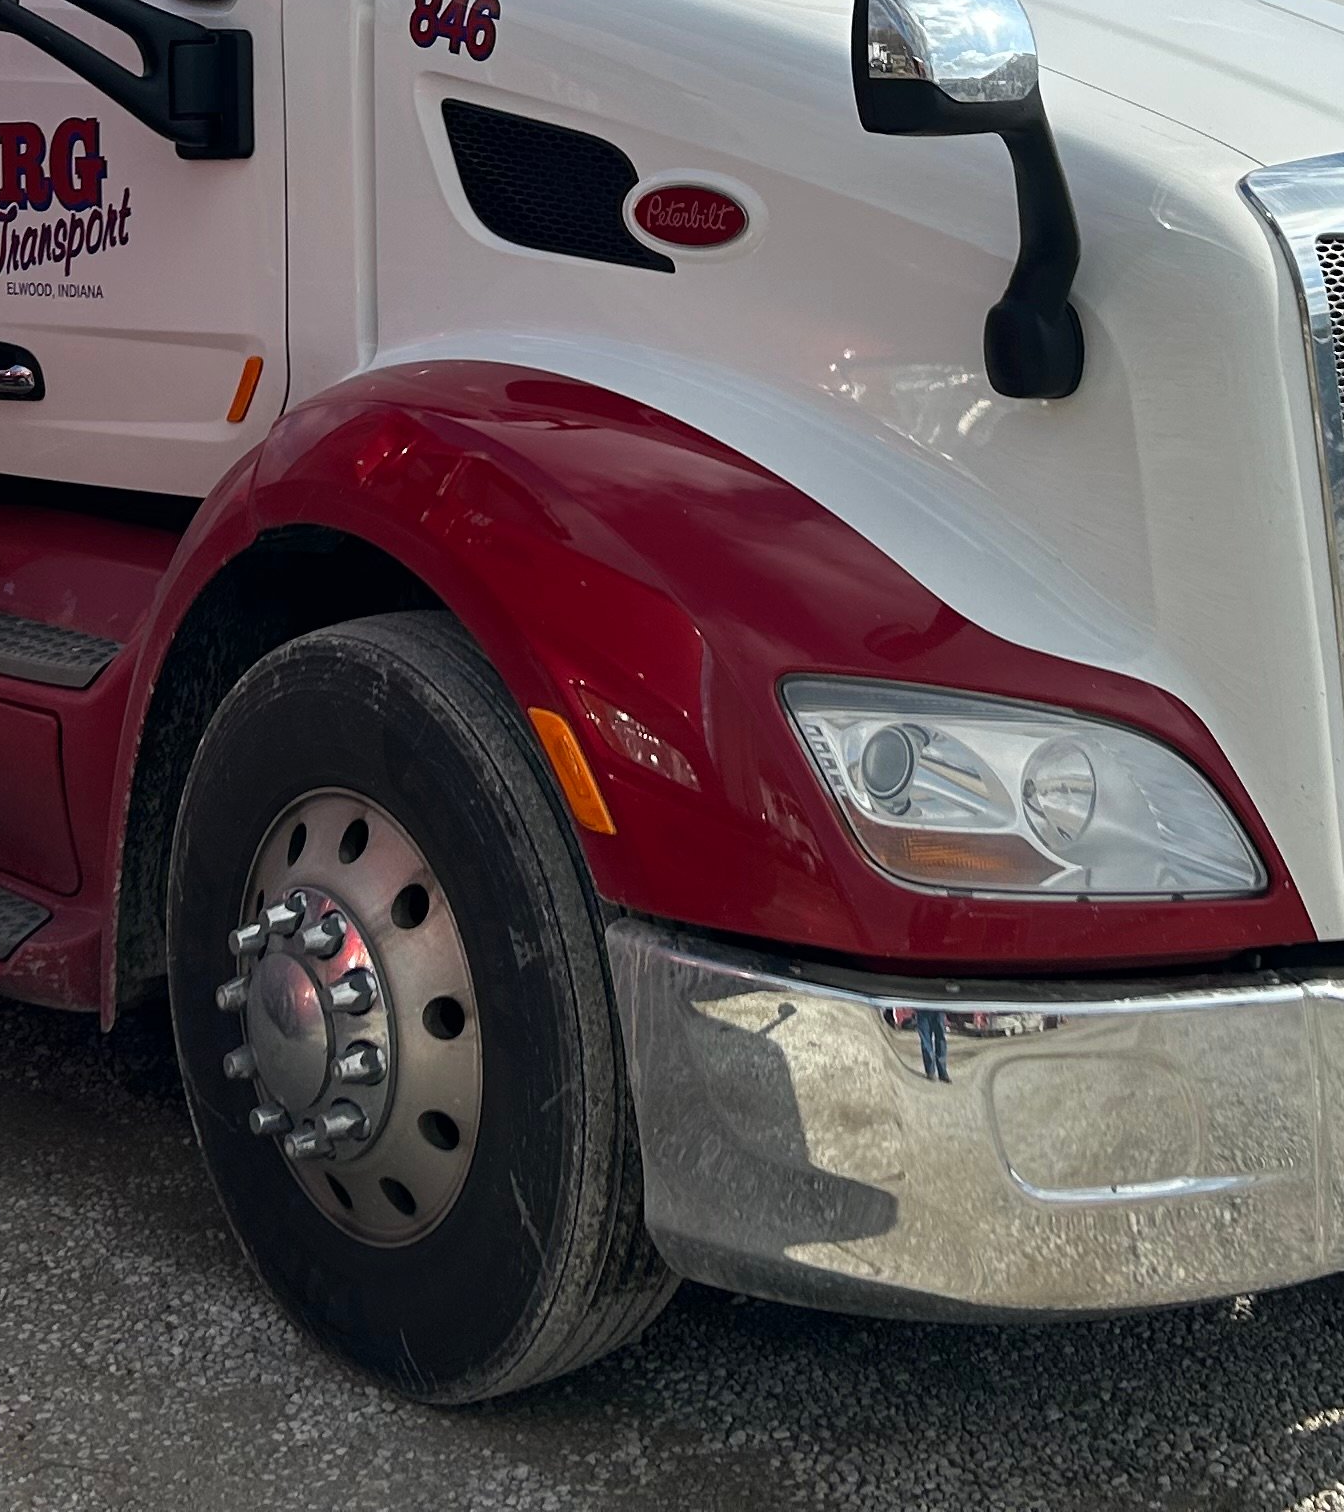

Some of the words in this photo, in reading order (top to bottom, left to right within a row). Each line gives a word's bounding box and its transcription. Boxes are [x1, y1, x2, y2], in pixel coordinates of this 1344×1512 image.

[645, 194, 736, 231] Peterbilt
[7, 282, 55, 299] ELWOOD,
[58, 284, 104, 299] INDIANA
